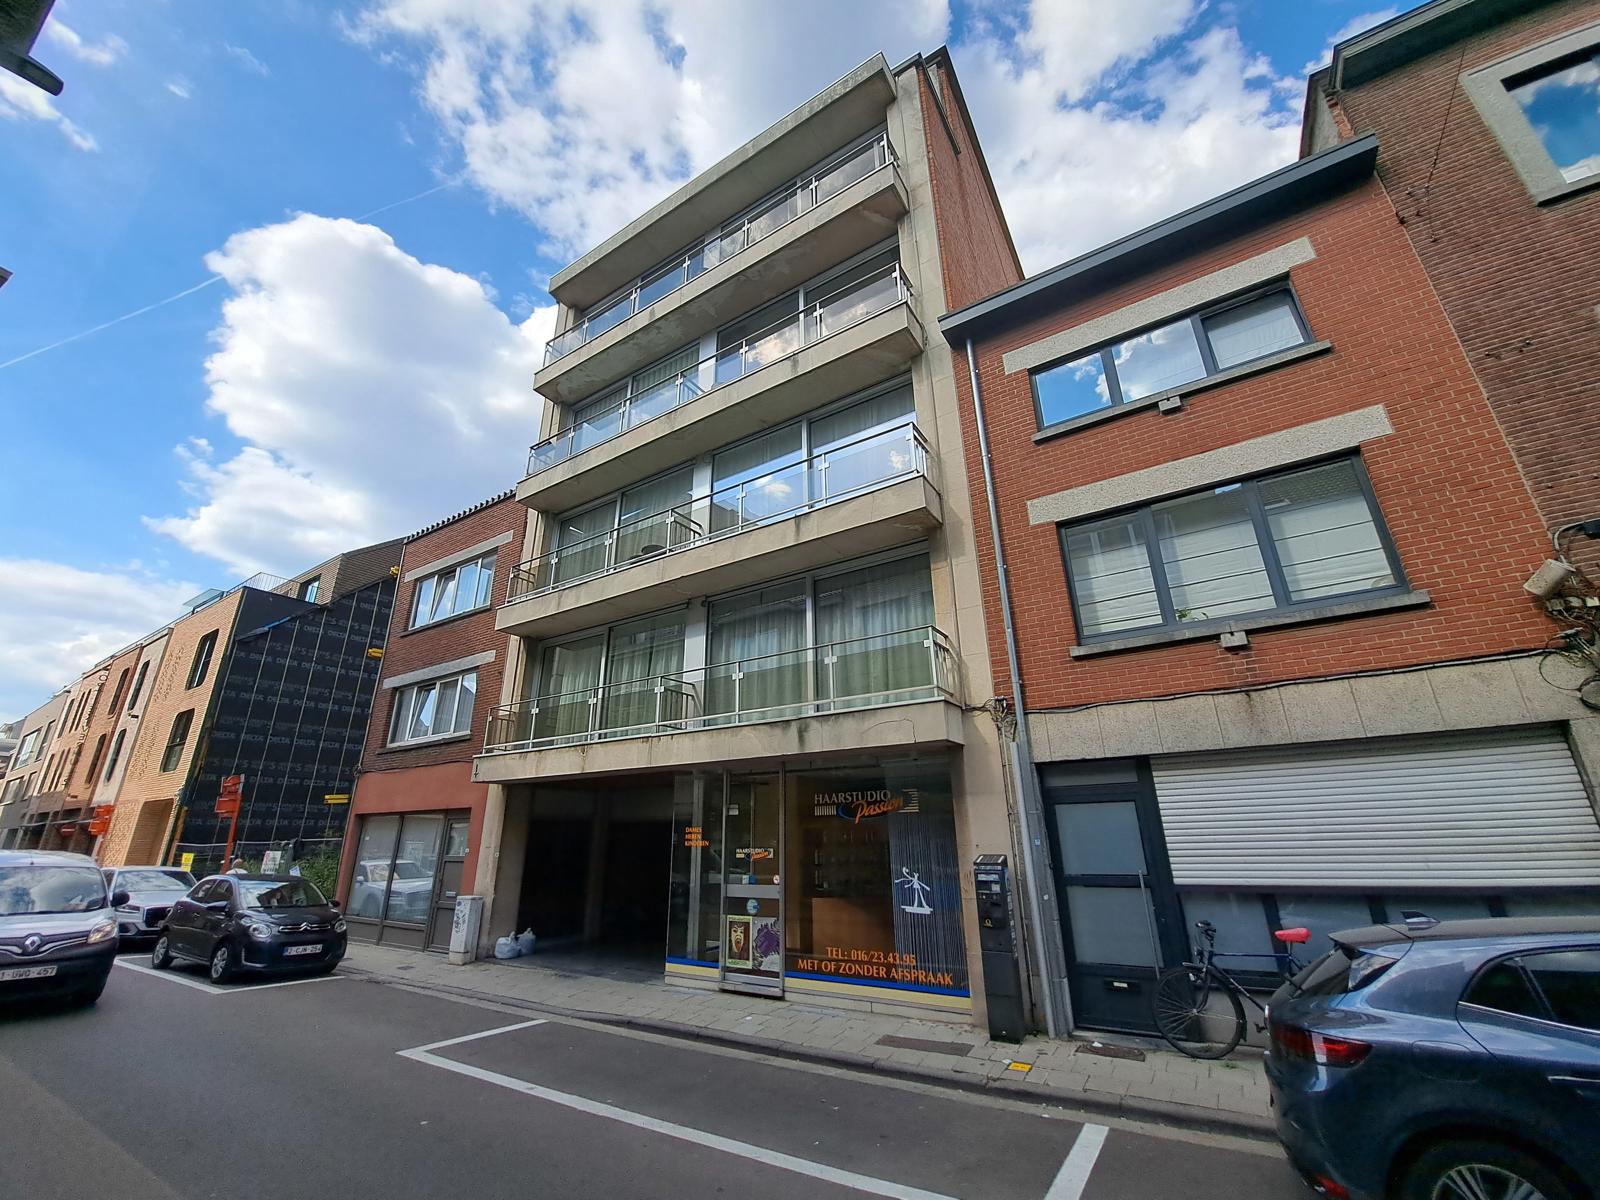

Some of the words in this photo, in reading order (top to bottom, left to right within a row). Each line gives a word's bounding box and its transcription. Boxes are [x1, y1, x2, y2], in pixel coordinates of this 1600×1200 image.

[814, 790, 890, 805] HAARSTUDIO
[826, 947, 848, 960] TEL:
[851, 950, 916, 967] 016/23.43.95
[797, 959, 818, 971] MET
[821, 960, 837, 973] OF
[839, 962, 887, 978] ZONDER
[889, 967, 953, 986] AFSPRAAK
